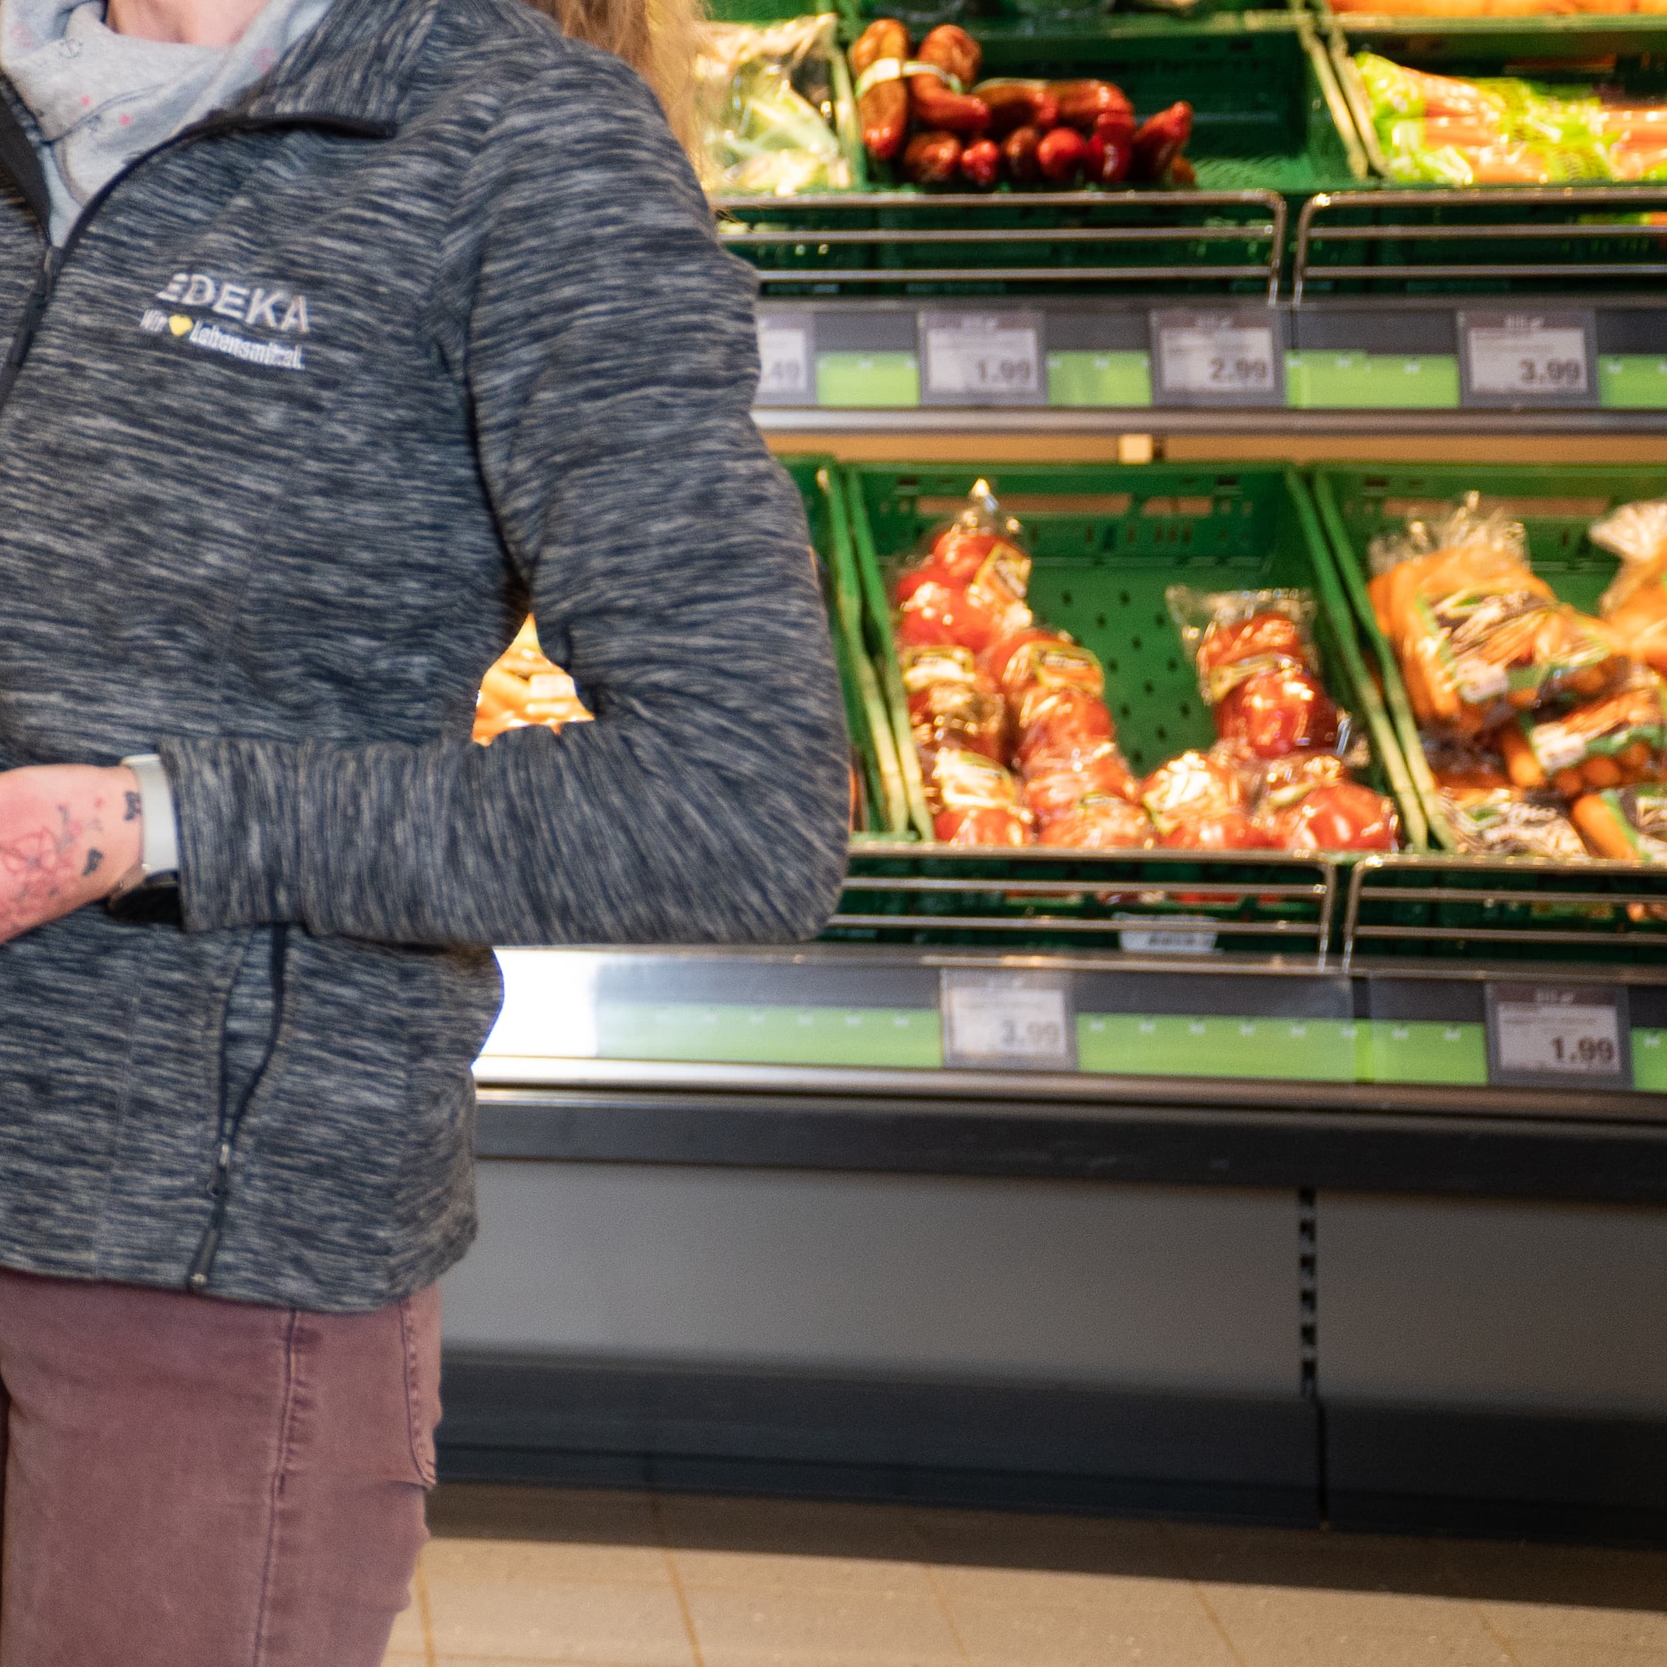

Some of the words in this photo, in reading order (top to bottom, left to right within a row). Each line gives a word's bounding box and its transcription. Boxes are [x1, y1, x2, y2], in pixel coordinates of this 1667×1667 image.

[155, 272, 311, 335] EDEKA
[1209, 357, 1267, 383] 2.99
[1518, 358, 1580, 384] 3.99
[1551, 1035, 1615, 1062] 1.99
